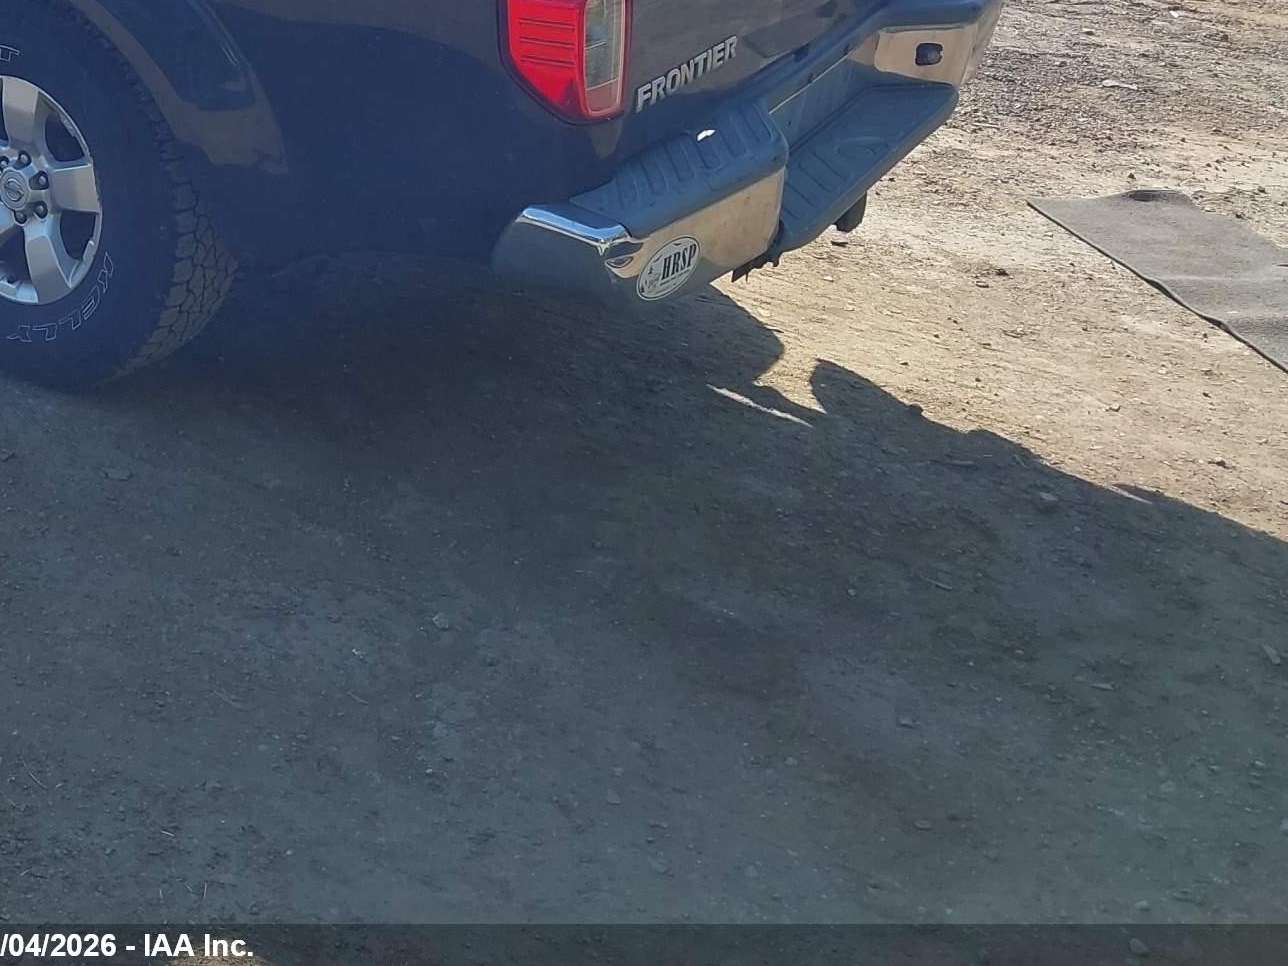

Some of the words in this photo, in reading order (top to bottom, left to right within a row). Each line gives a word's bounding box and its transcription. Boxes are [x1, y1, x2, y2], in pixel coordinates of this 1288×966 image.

[634, 35, 738, 114] FRONTIER
[6, 251, 113, 342] KELLY
[660, 243, 697, 281] HRSP
